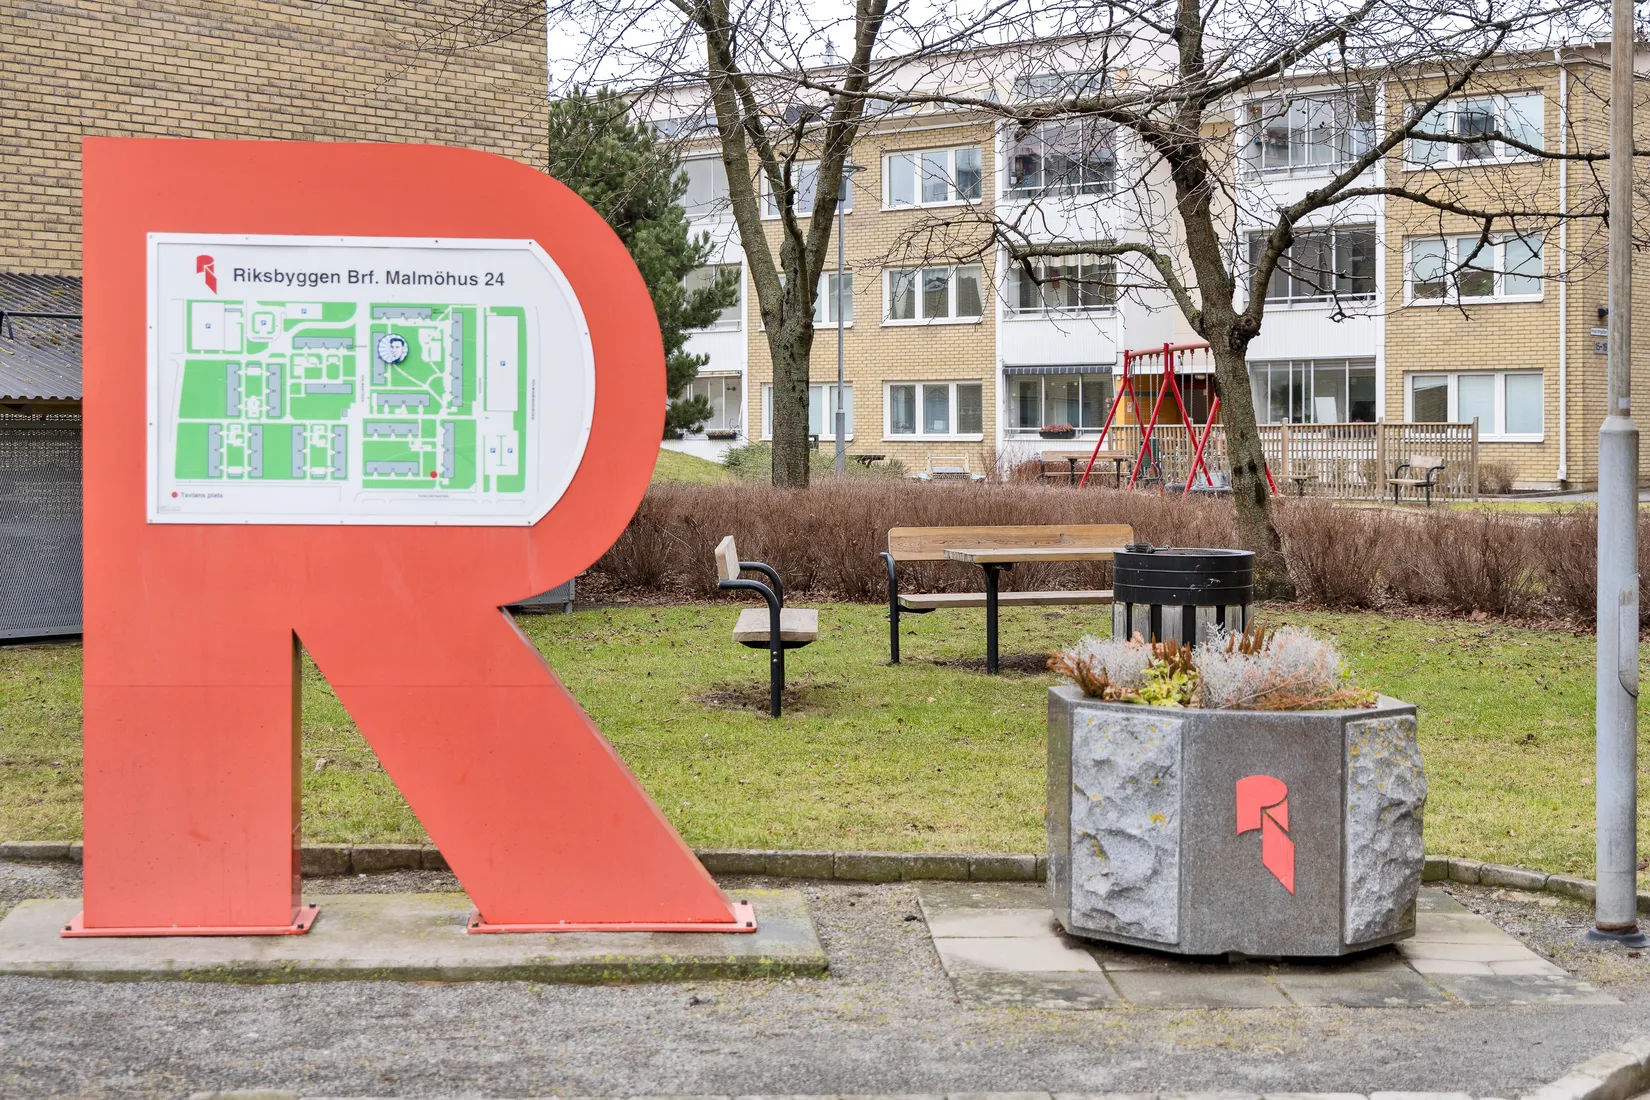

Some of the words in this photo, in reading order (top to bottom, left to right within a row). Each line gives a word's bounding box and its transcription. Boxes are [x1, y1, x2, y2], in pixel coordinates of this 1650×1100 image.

[233, 267, 341, 287] Riksbyggen
[348, 270, 379, 284] Brf.
[386, 270, 478, 286] Malmöhus
[484, 272, 505, 286] 24
